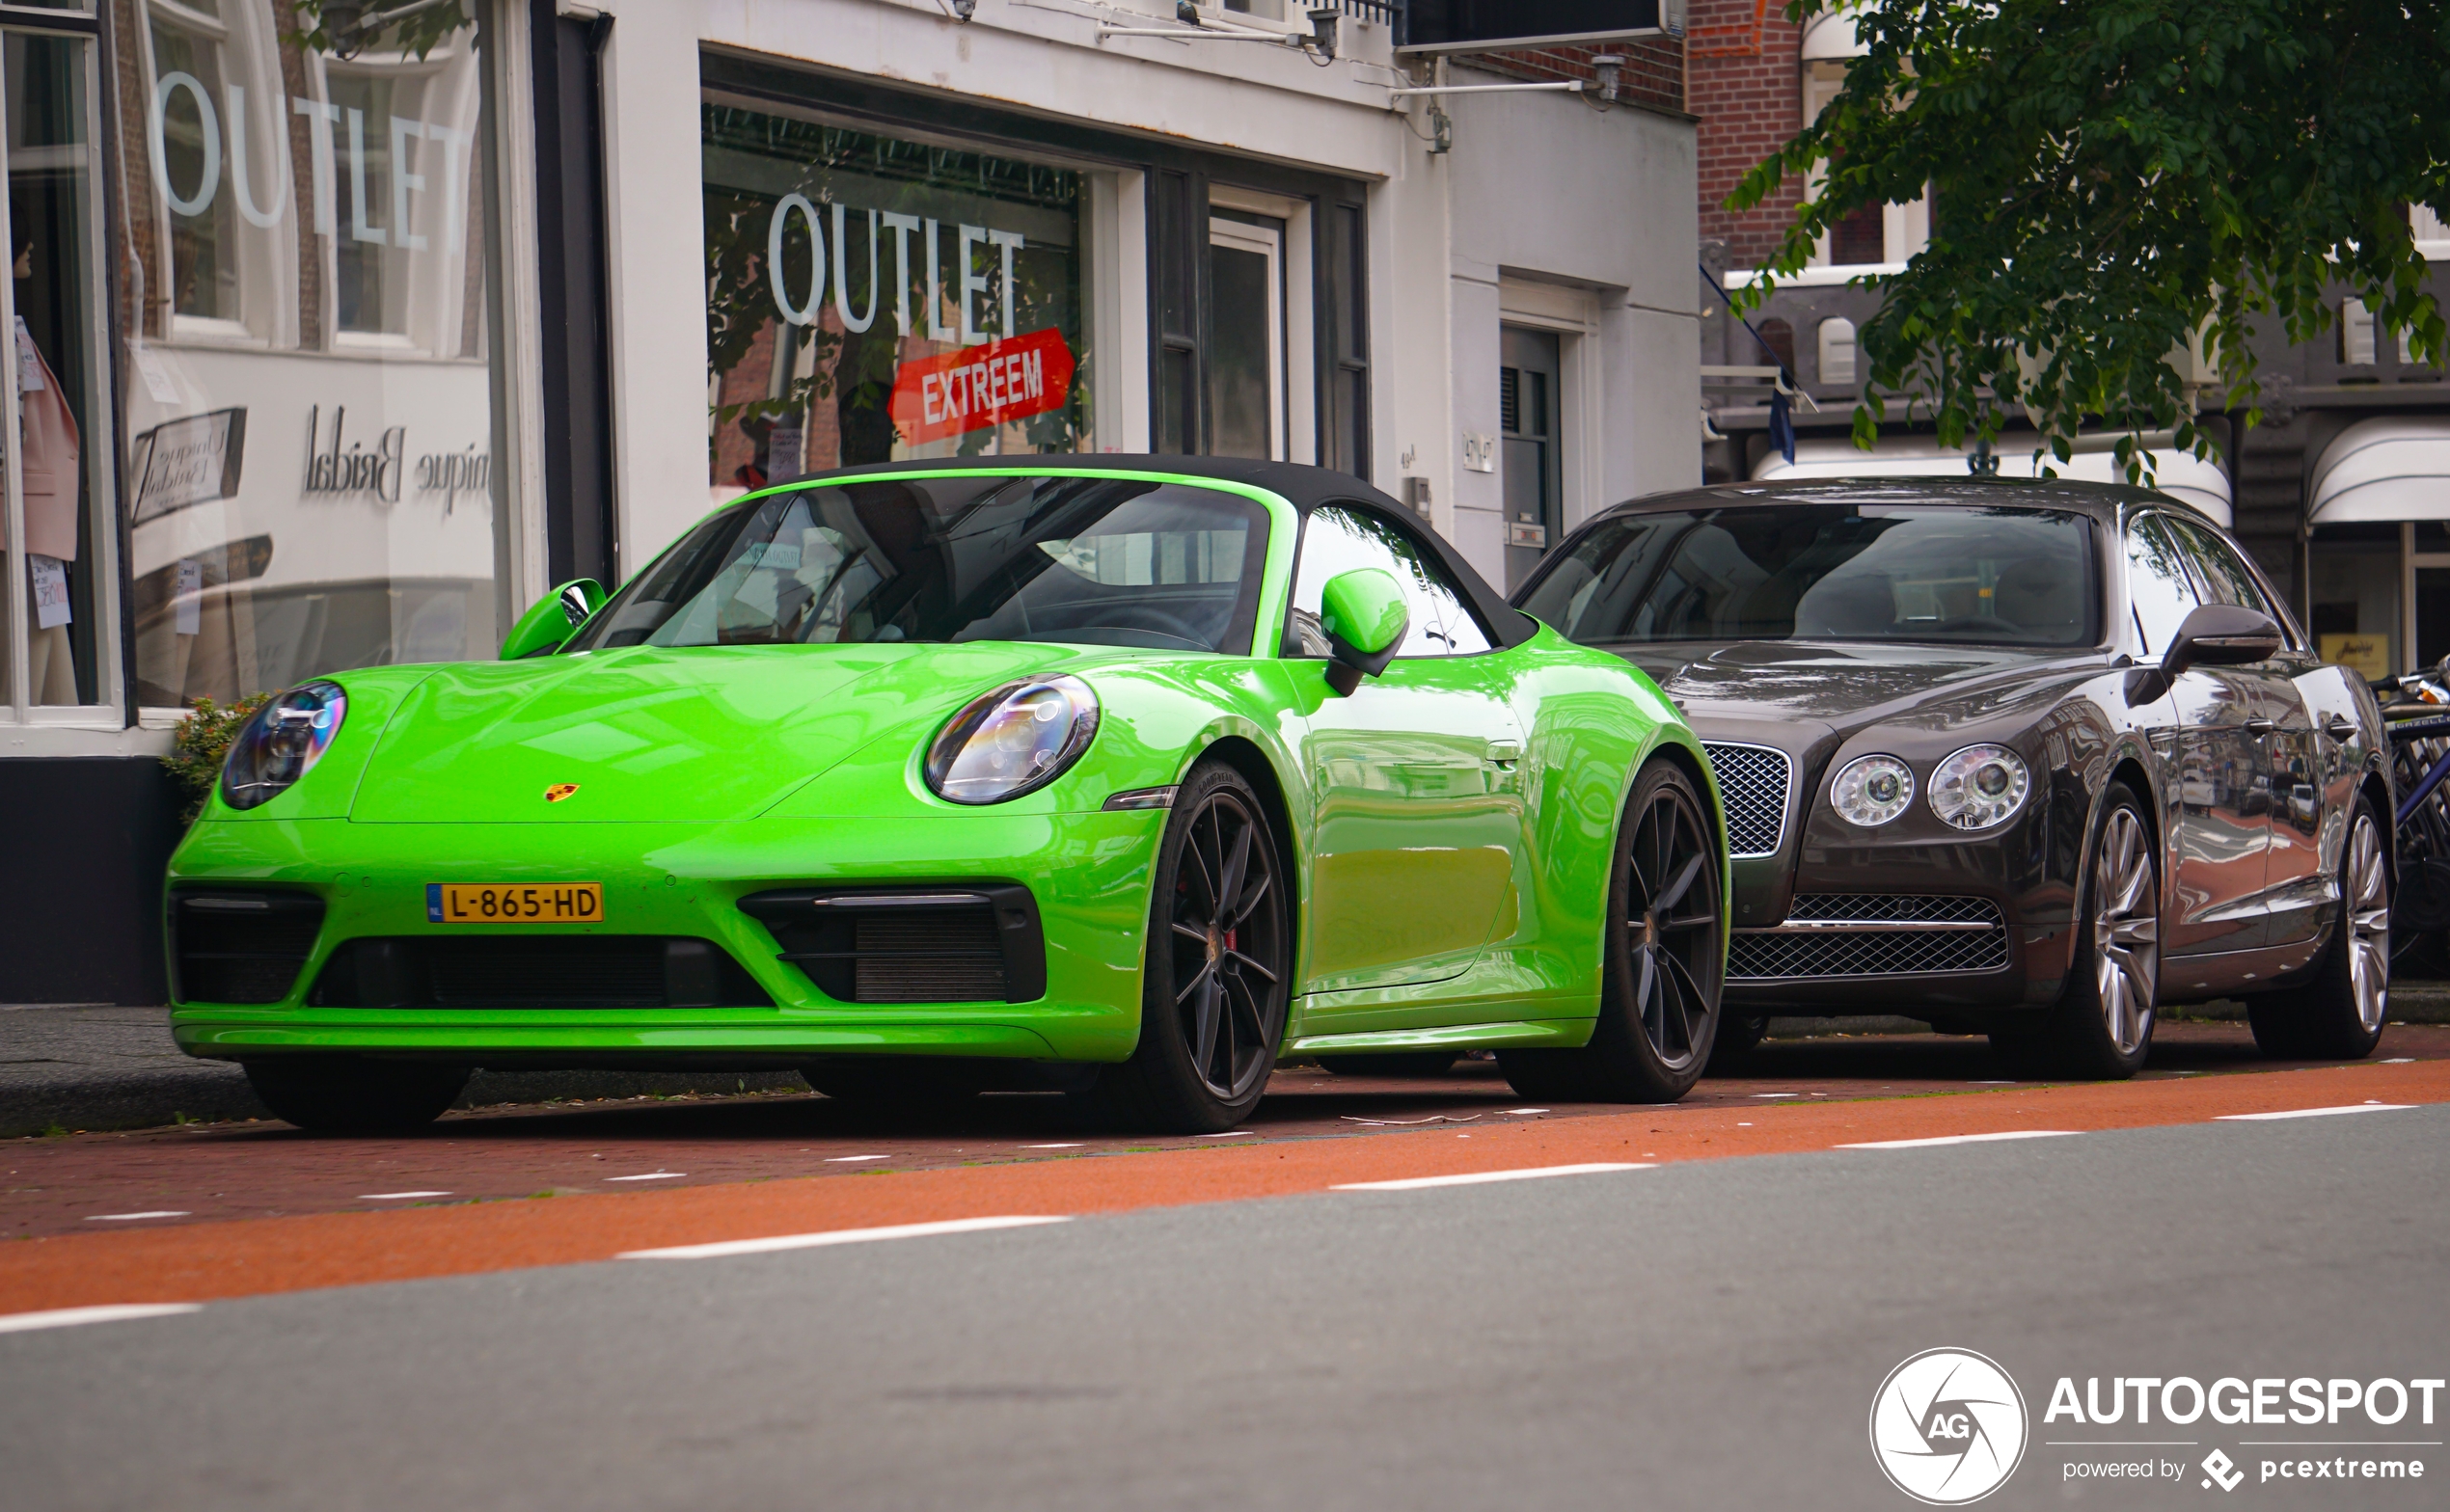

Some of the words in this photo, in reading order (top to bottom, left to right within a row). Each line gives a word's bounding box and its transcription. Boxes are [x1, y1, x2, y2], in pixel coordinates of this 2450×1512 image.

[148, 71, 472, 254] OUTLET
[768, 193, 1024, 345] OUTLET
[922, 349, 1045, 426] EXTREEM
[429, 907, 442, 916] NL
[451, 889, 596, 917] L-865-HD
